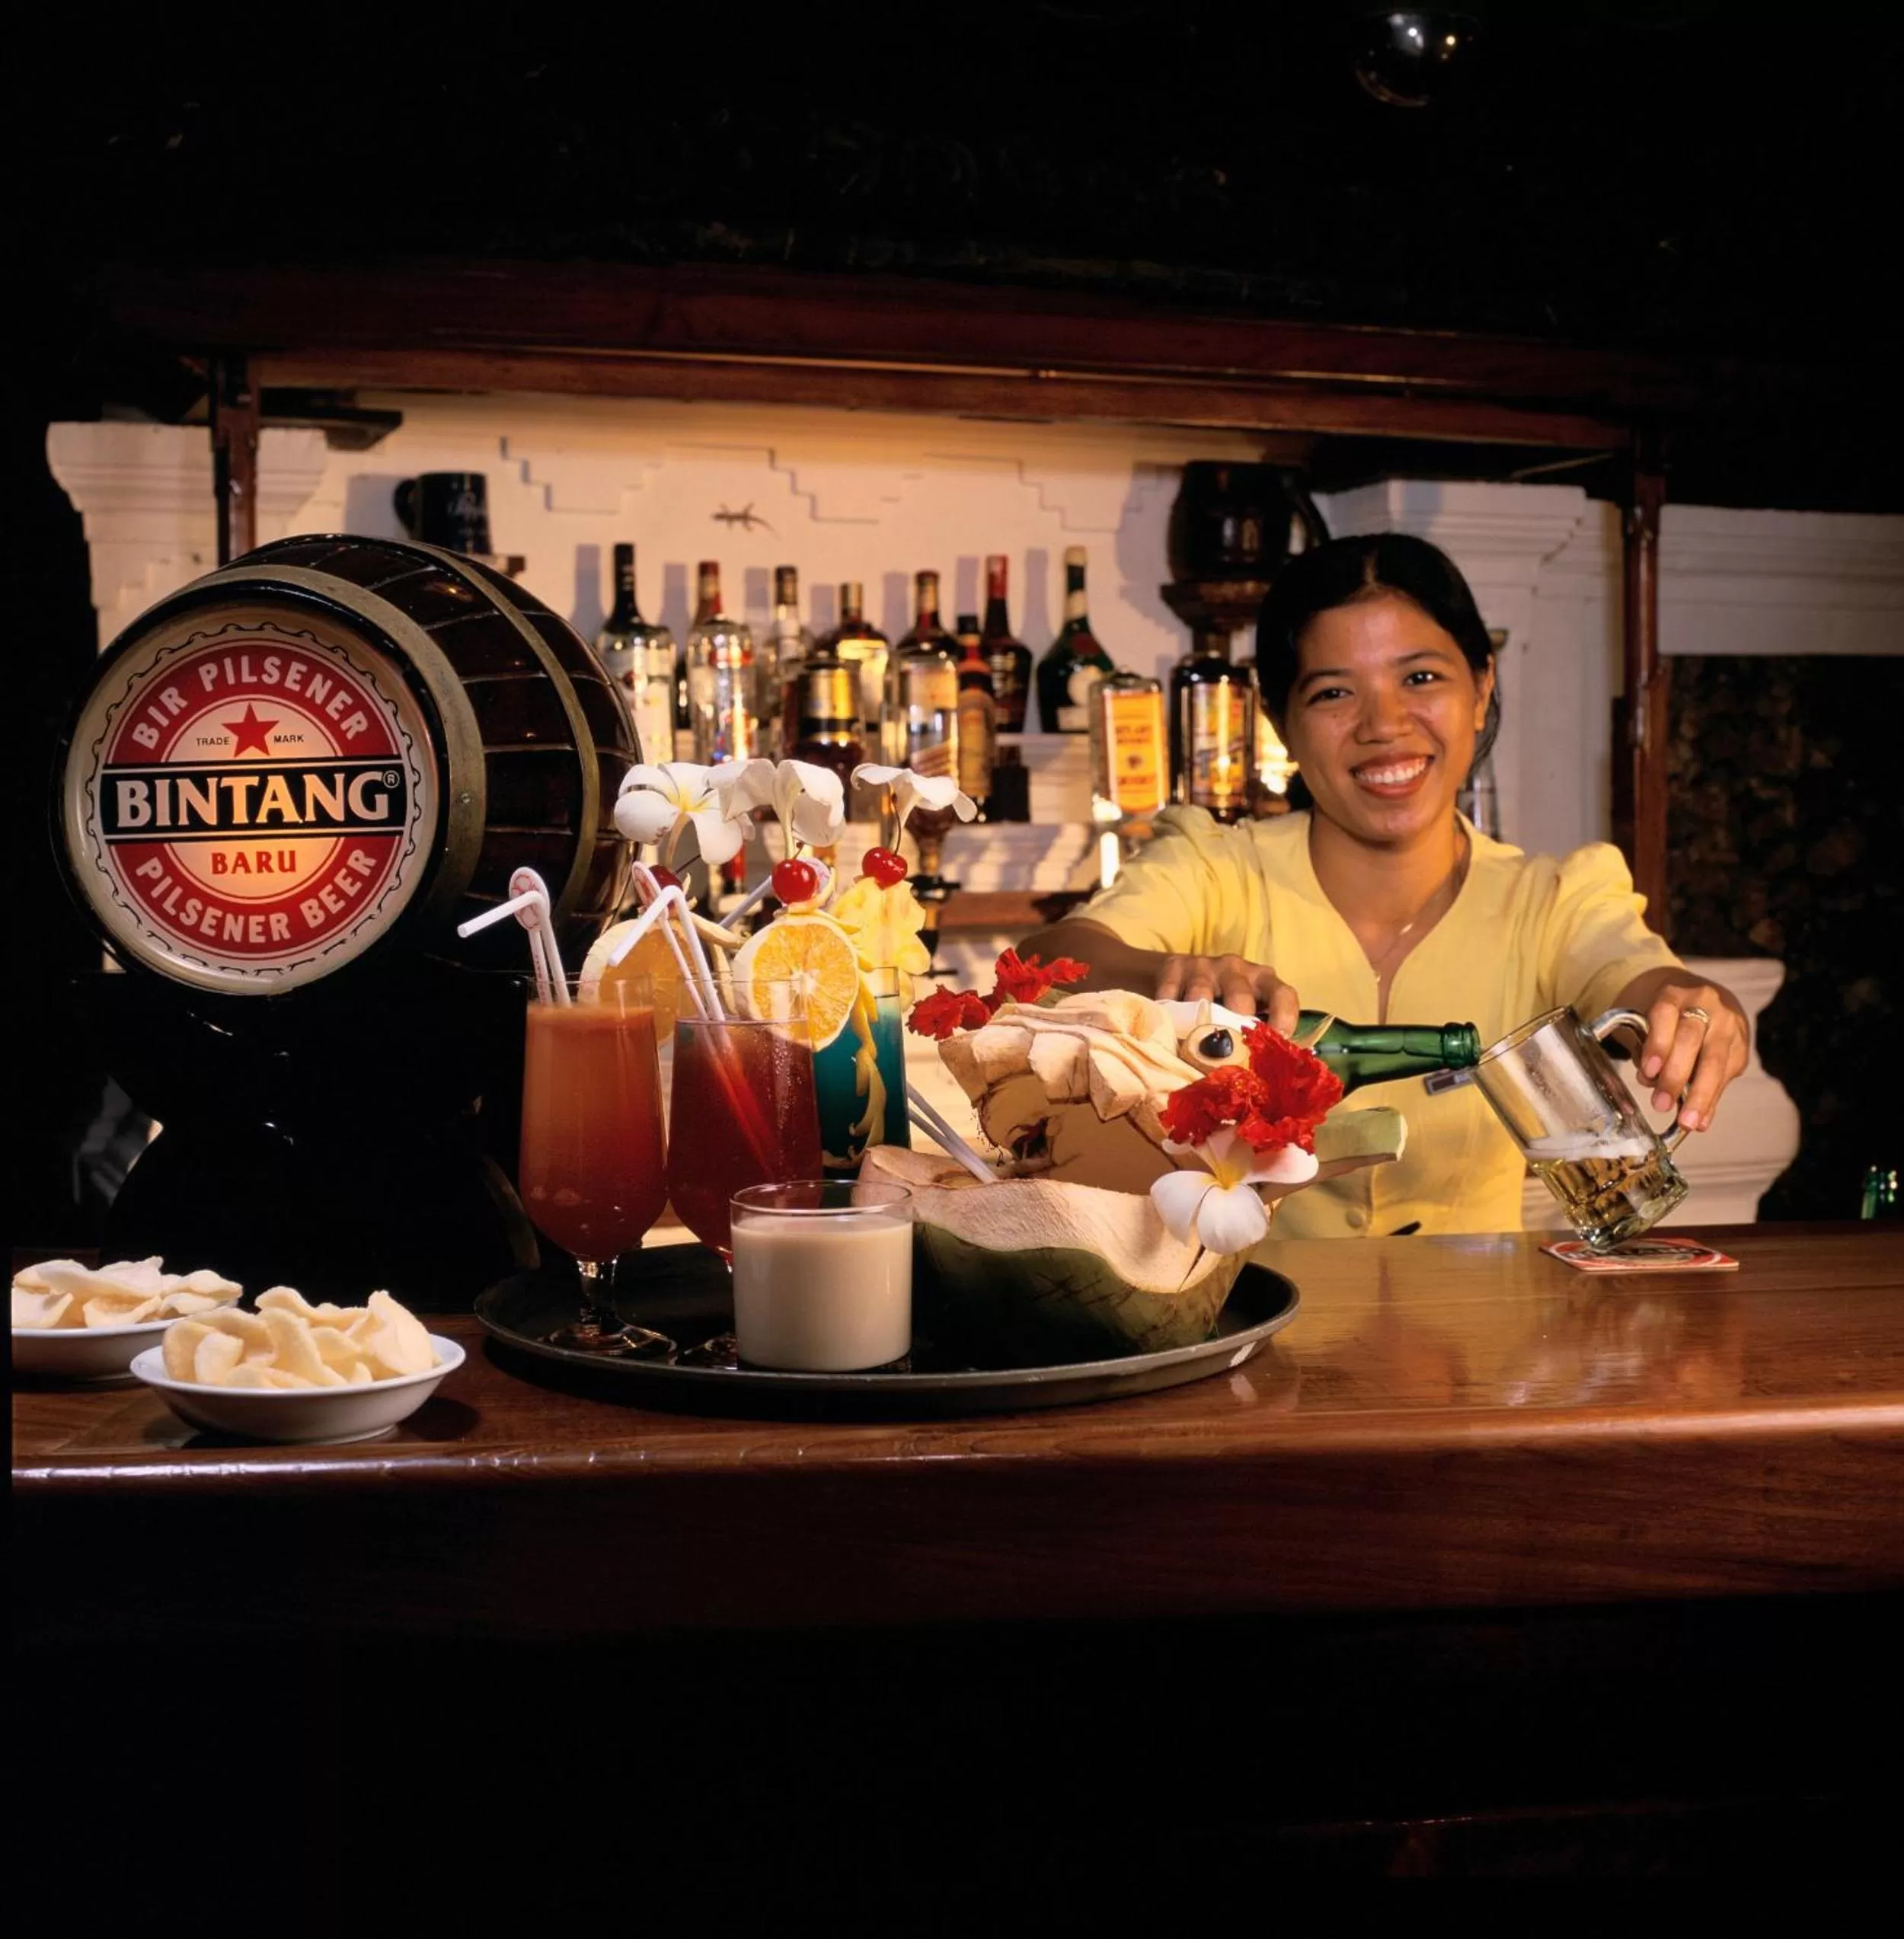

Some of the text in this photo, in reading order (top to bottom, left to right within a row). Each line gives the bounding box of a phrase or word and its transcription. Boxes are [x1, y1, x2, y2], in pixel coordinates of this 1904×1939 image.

[132, 655, 369, 750] BIR PILSENER
[196, 733, 305, 746] TRADE MARK
[211, 850, 297, 875] BARU
[136, 848, 377, 944] PILSENER BEER
